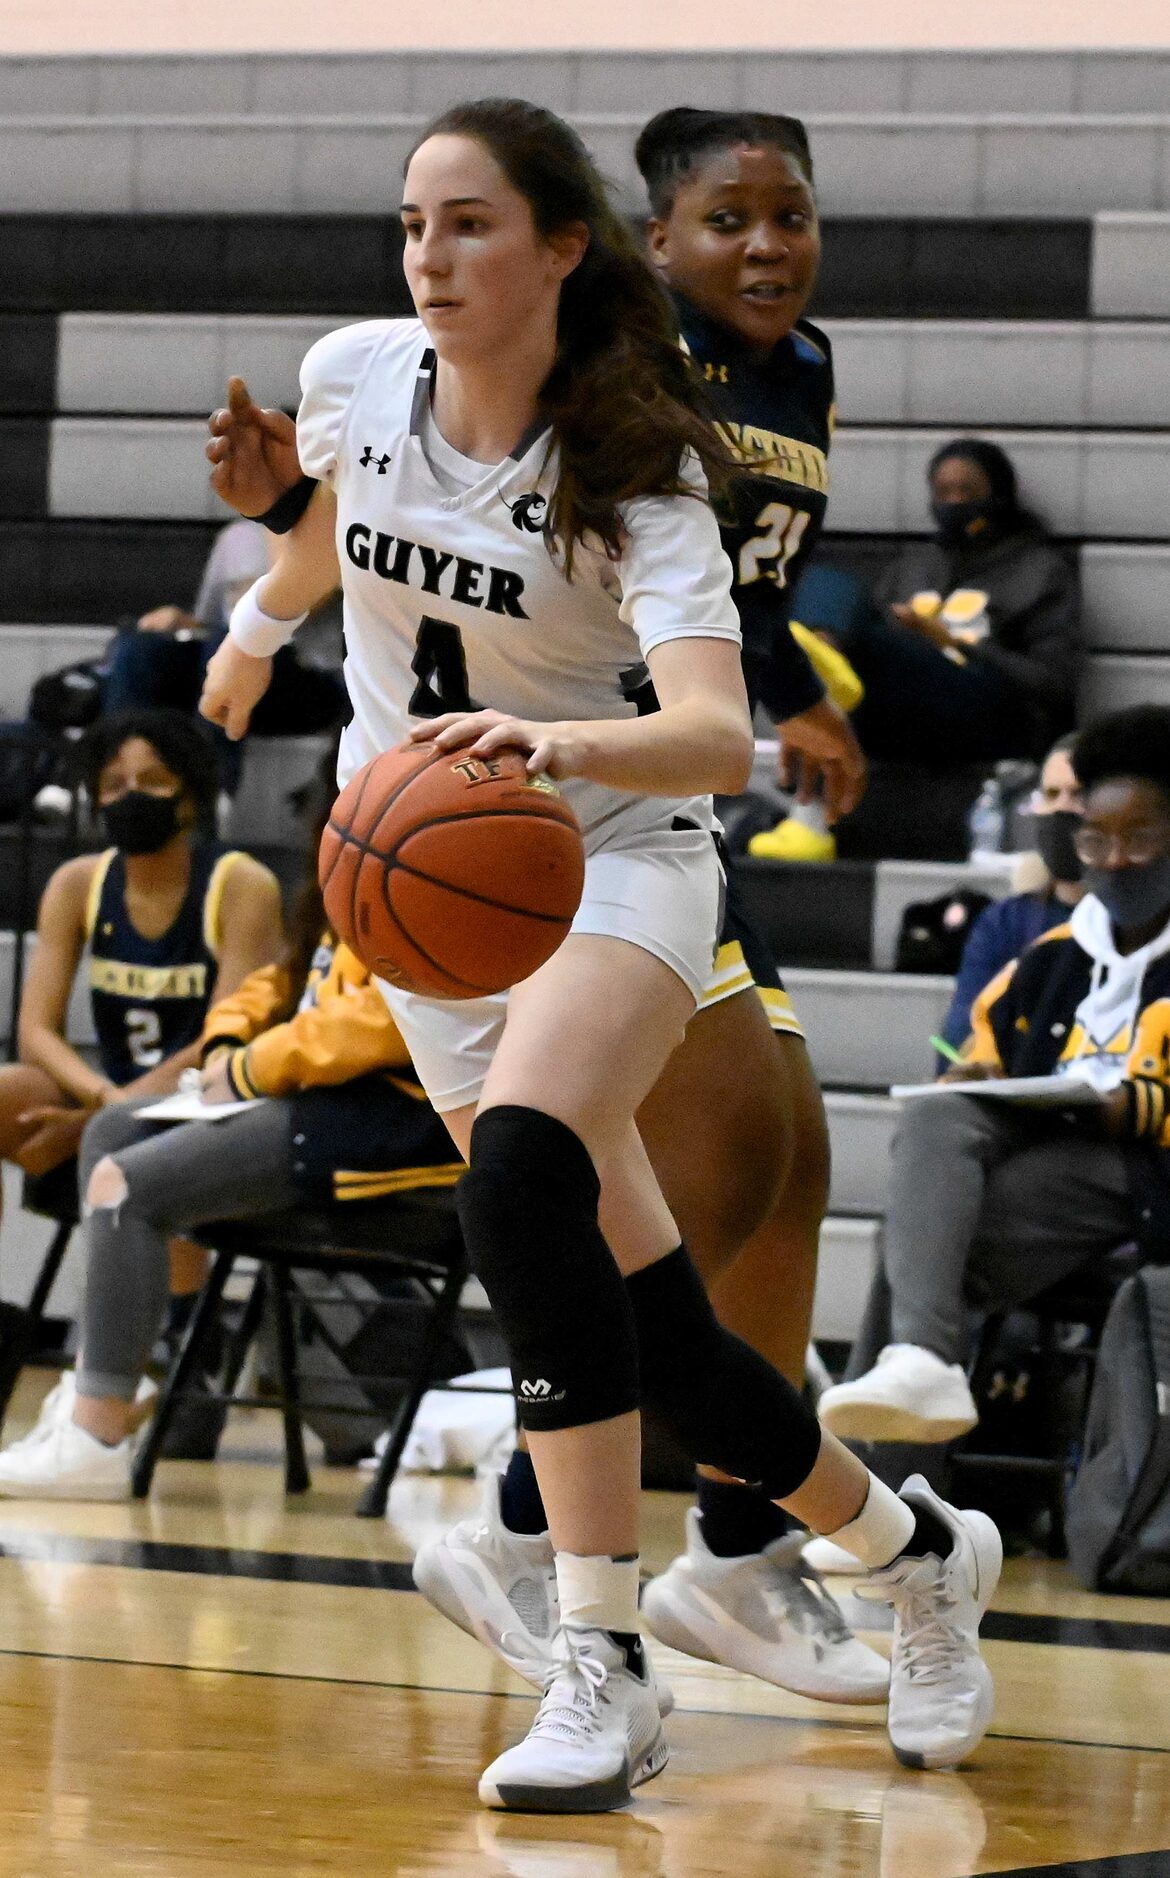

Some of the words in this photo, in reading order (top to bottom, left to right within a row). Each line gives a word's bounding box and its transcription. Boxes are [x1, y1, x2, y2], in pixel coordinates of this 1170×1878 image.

[346, 522, 531, 620] GUYER
[738, 502, 811, 589] 21
[408, 614, 487, 719] 4
[125, 1007, 163, 1067] 2
